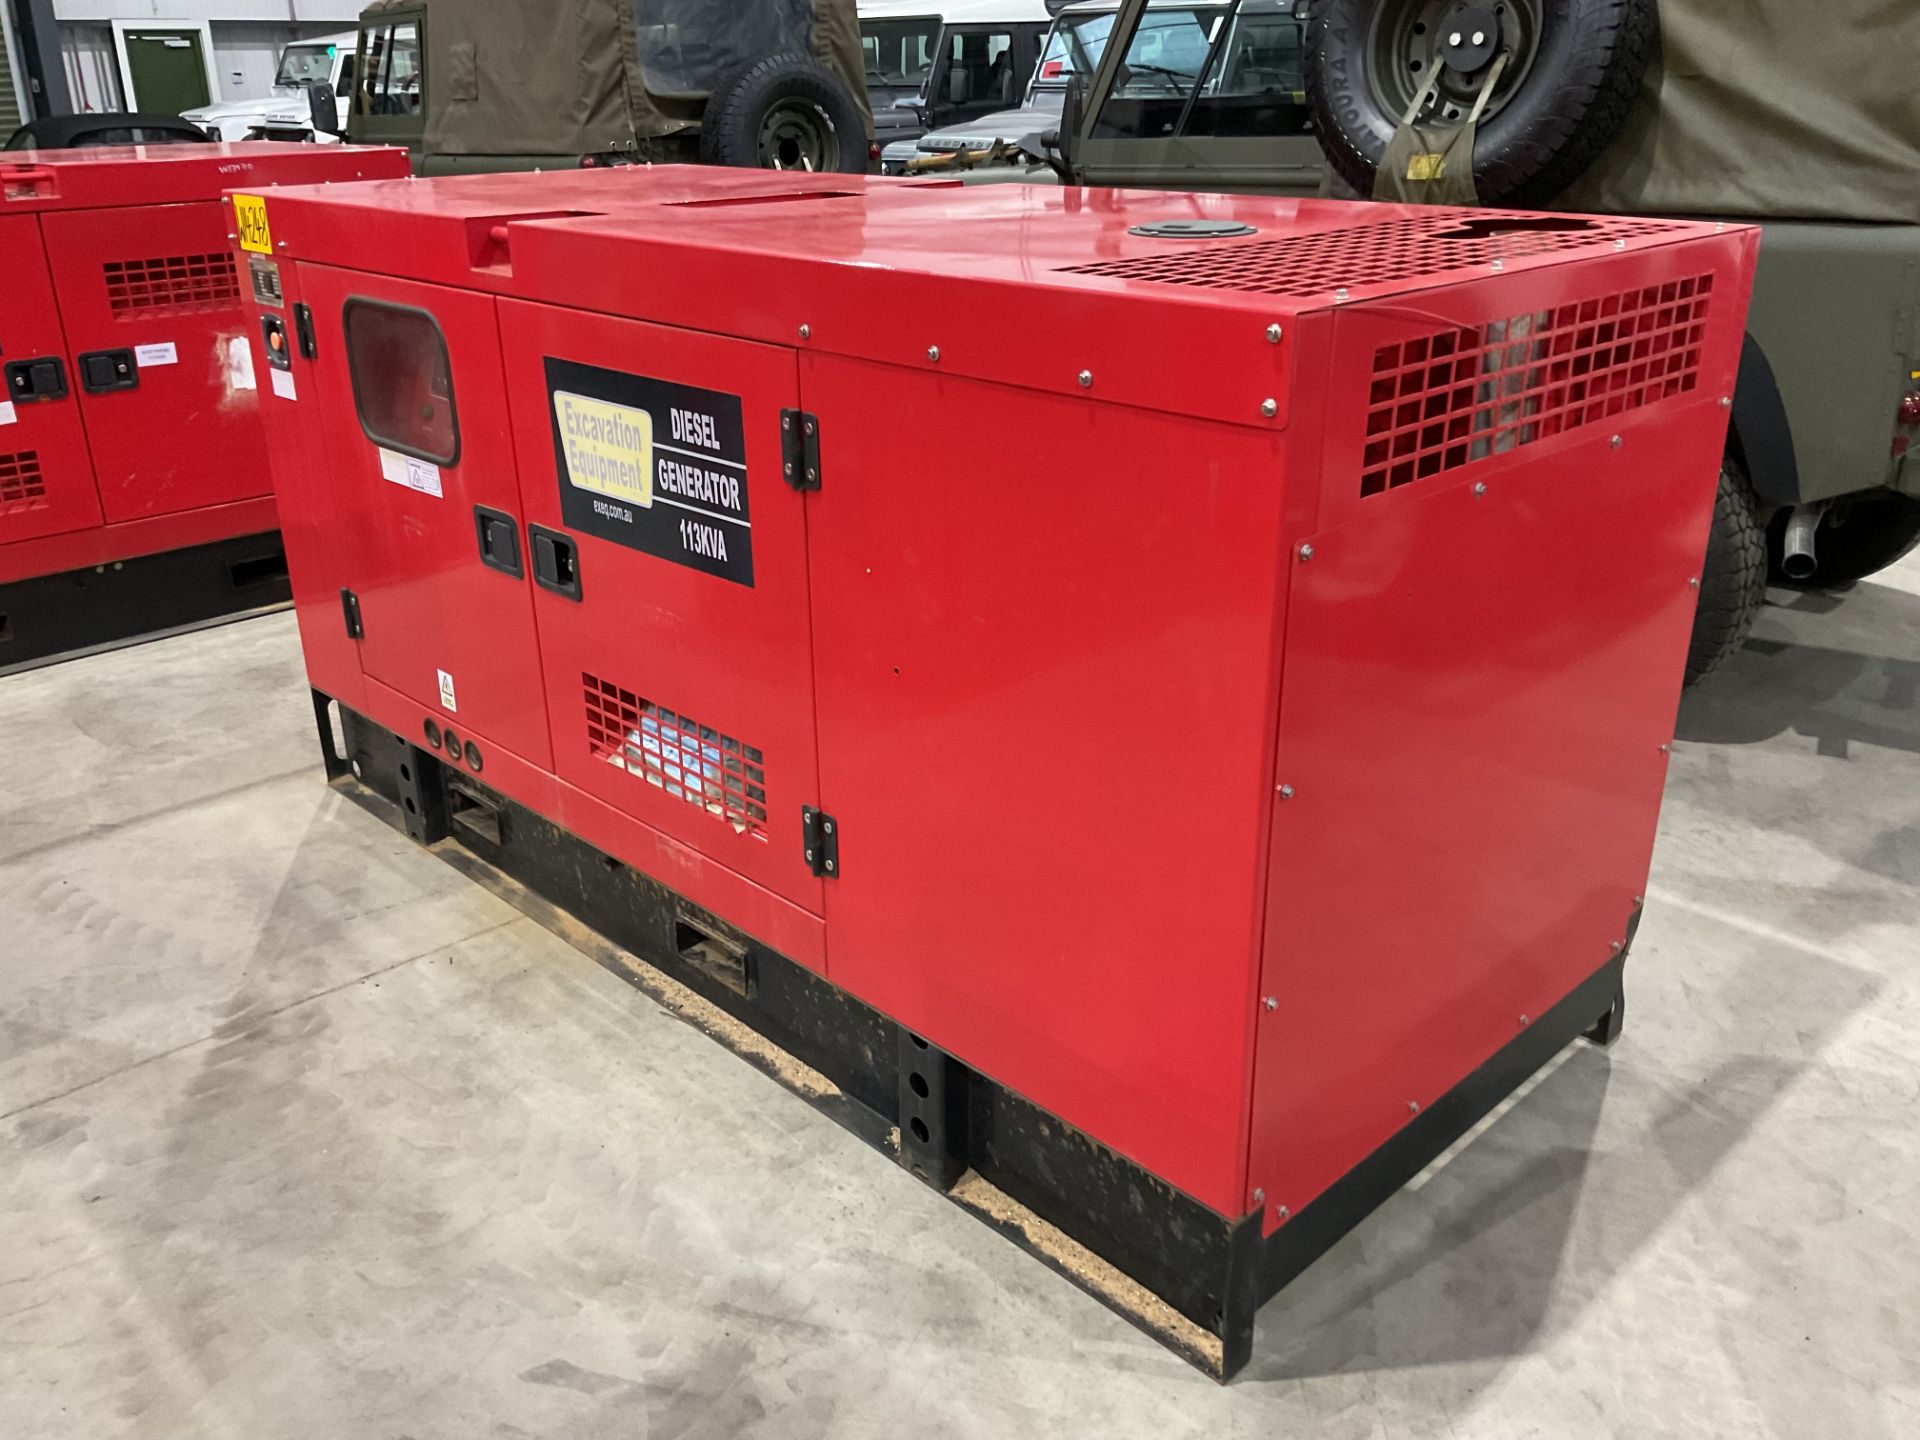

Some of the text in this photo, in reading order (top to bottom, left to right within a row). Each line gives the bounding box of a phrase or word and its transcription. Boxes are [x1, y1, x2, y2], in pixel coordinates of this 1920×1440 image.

[564, 400, 642, 453] Excavation
[670, 407, 721, 450] DIESEL
[569, 439, 644, 493] Equipment
[658, 458, 742, 511] GENERATOR
[593, 499, 633, 523] exeq.com.au
[679, 518, 728, 562] 113KVA
